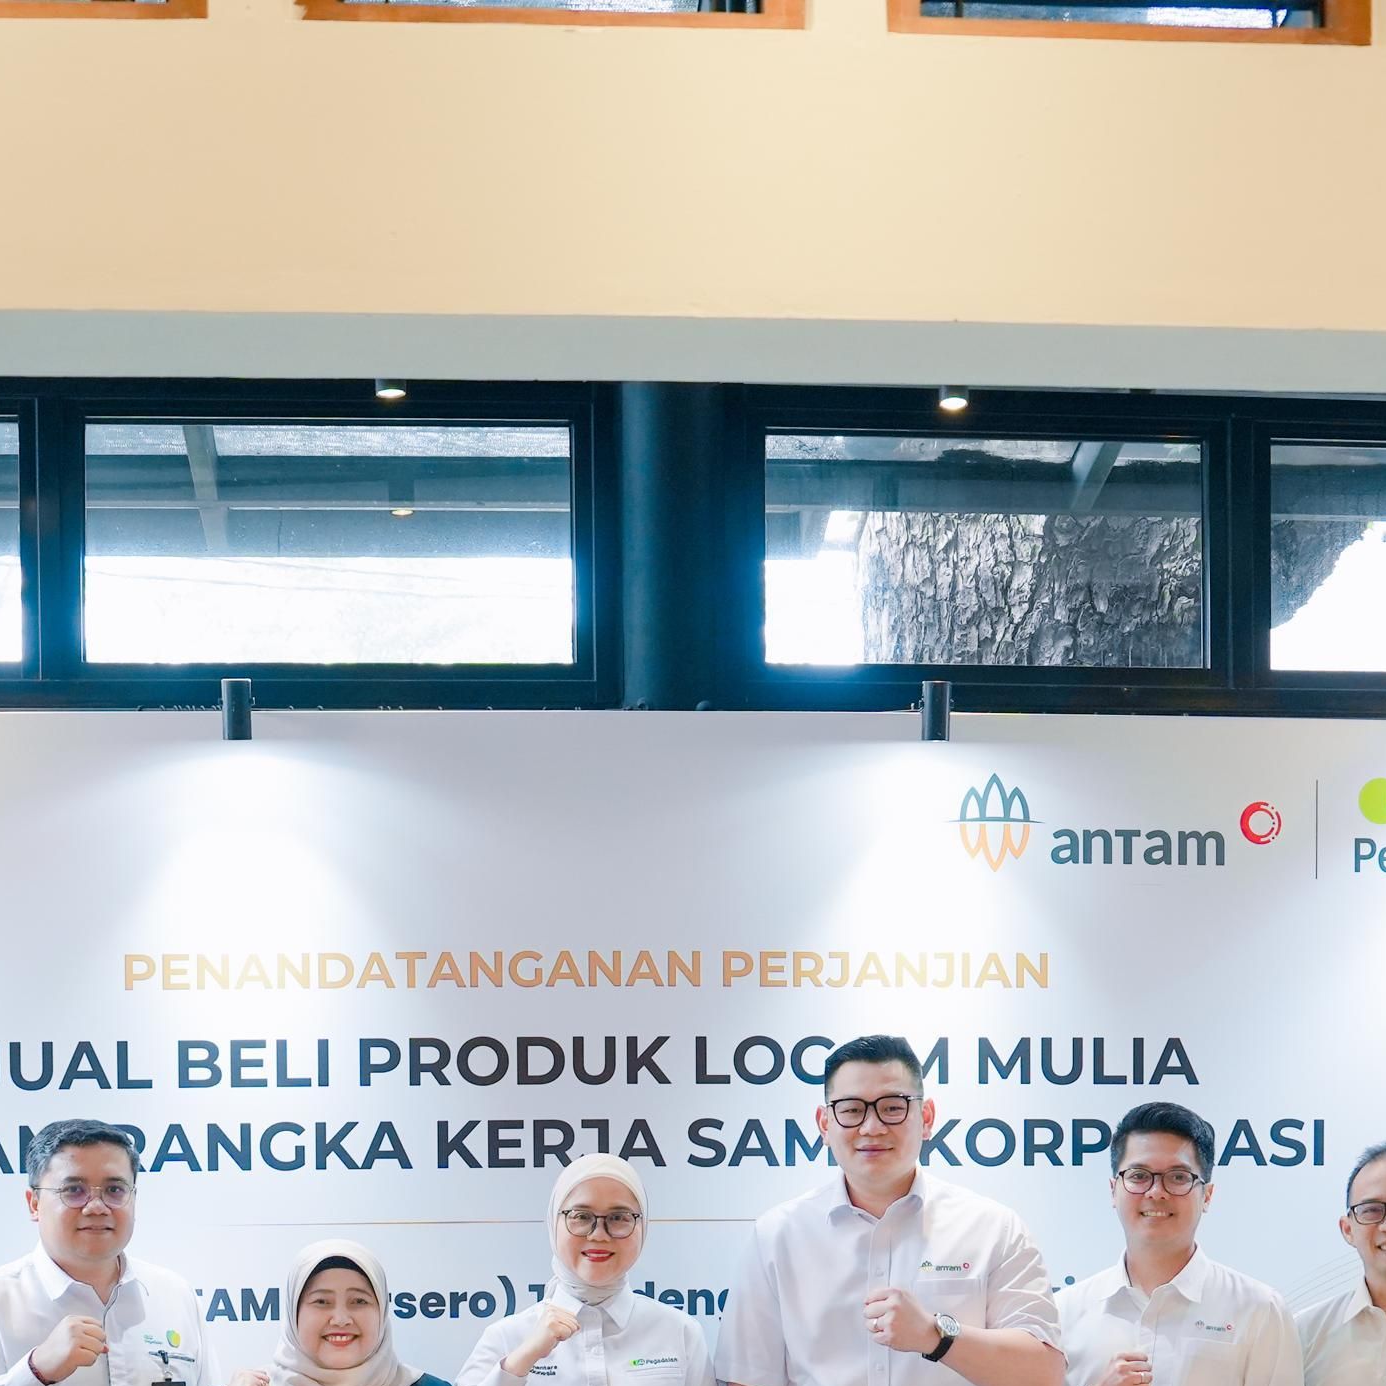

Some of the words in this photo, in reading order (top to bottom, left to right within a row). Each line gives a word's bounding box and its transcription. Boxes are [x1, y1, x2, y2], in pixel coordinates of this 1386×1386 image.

[123, 949, 701, 991] PENANDATANGANAN
[722, 949, 1050, 989] PERJANJIAN
[176, 1039, 330, 1089] BELI
[358, 1034, 673, 1088] PRODUK
[695, 1034, 949, 1085] LOGM
[977, 1036, 1199, 1086] MULIA
[687, 1117, 836, 1168] SAM
[919, 1117, 1325, 1168] KORPASI
[388, 1275, 517, 1319] sero)
